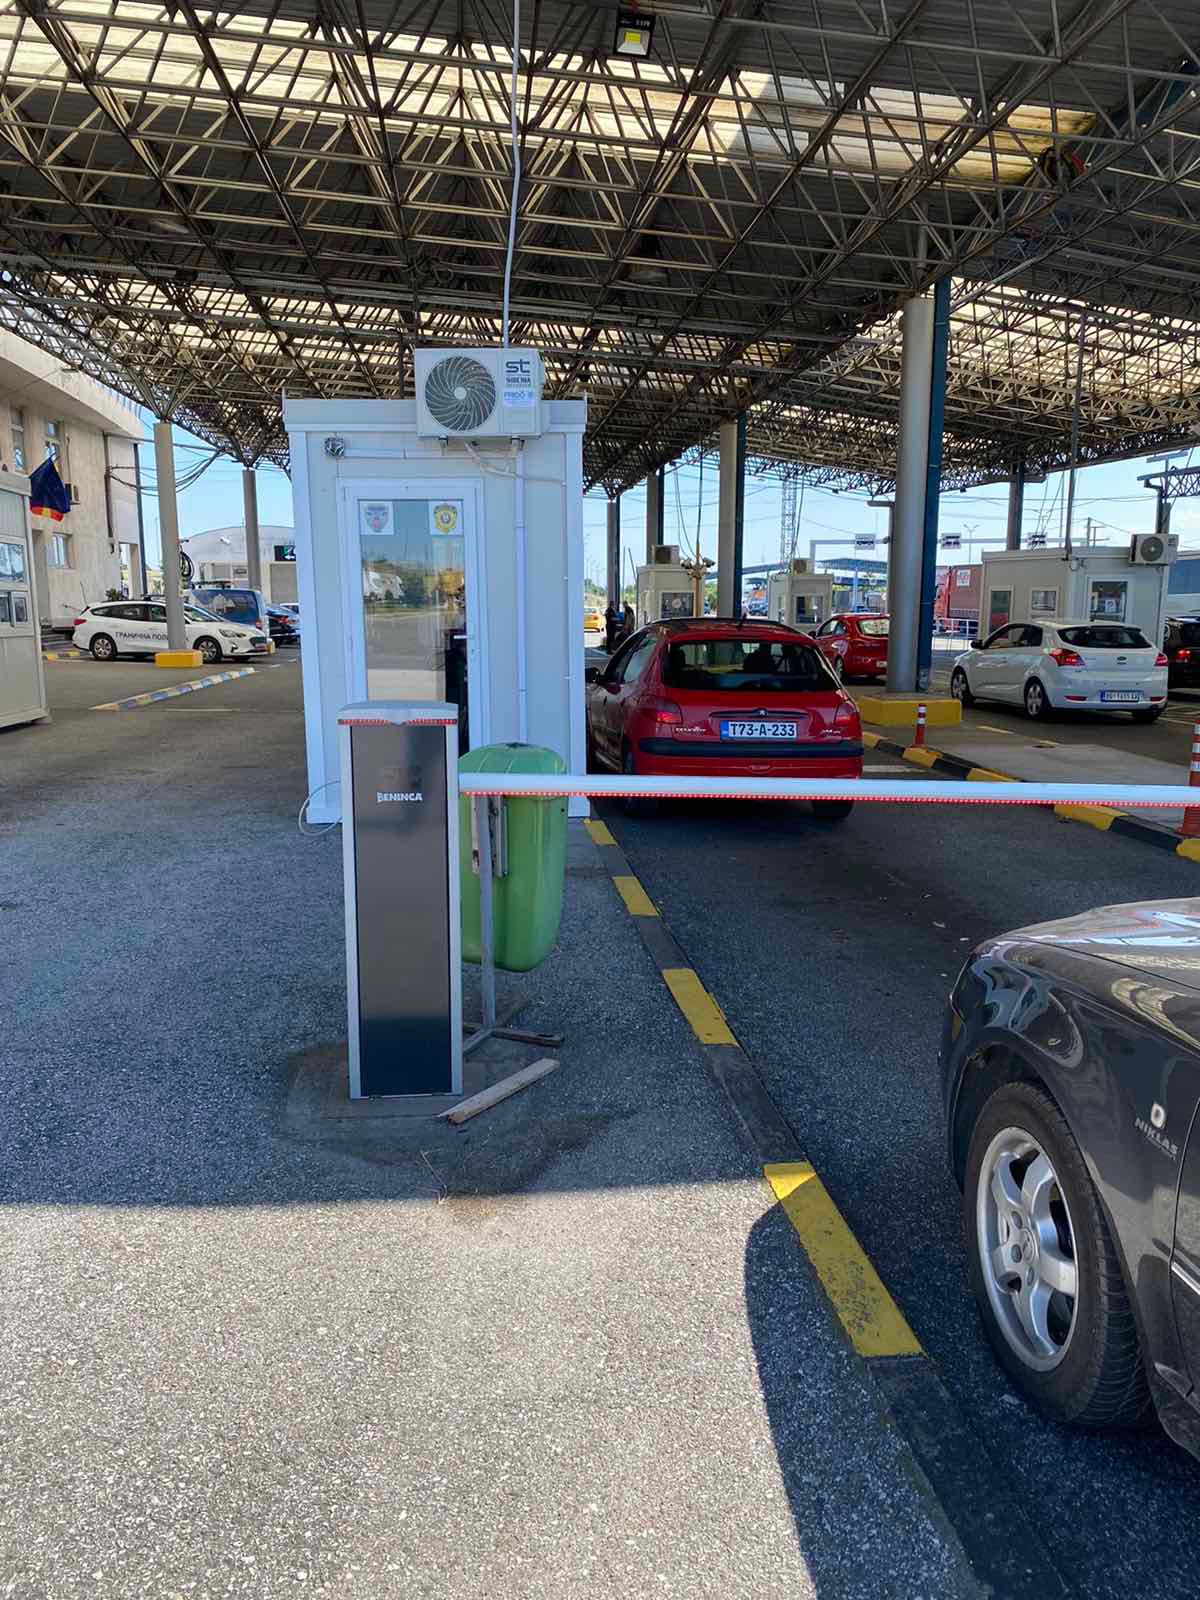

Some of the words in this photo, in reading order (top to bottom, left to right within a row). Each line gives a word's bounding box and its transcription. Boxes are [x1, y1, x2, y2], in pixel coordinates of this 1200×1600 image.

[730, 723, 795, 737] T73-A-233
[376, 791, 423, 803] BENINCA
[1134, 1117, 1179, 1156] NIKLAS
